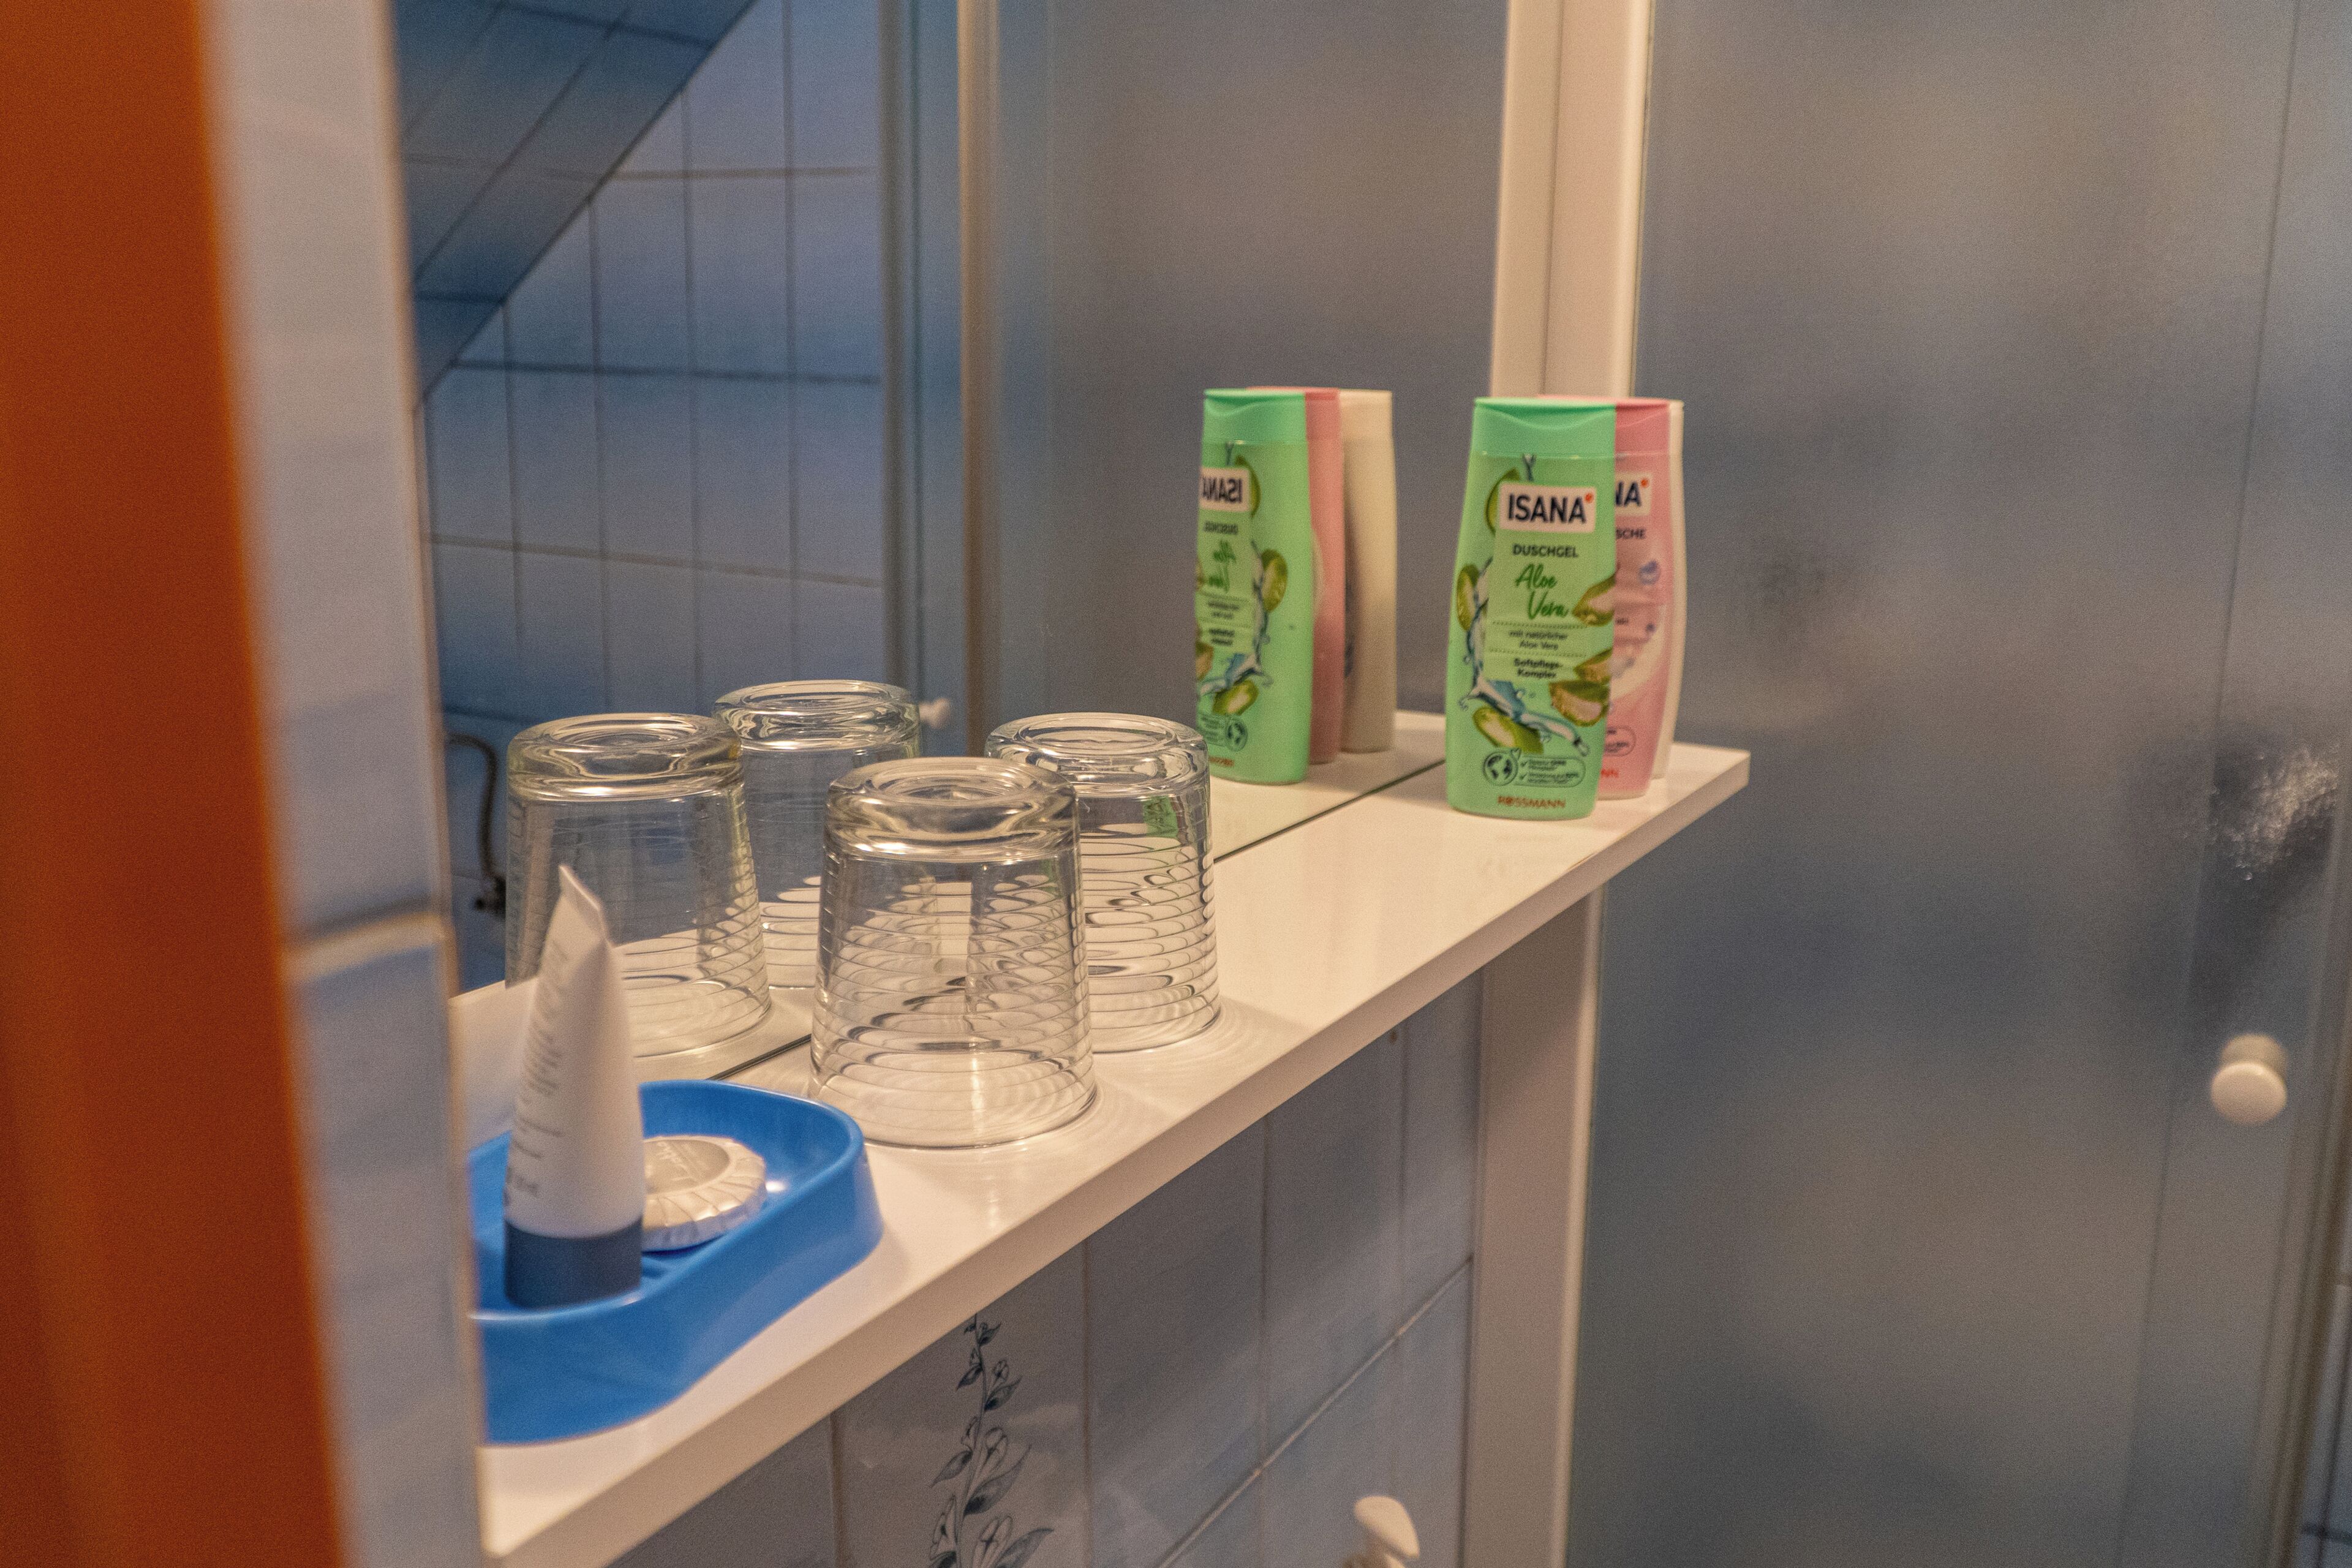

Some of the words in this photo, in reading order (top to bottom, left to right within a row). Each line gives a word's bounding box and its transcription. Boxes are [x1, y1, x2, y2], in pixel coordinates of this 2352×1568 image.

[1508, 492, 1587, 524] ISANA
[1512, 543, 1578, 558] DUSCHGEL
[1515, 563, 1558, 590] Aloe
[1527, 590, 1569, 620] Vera
